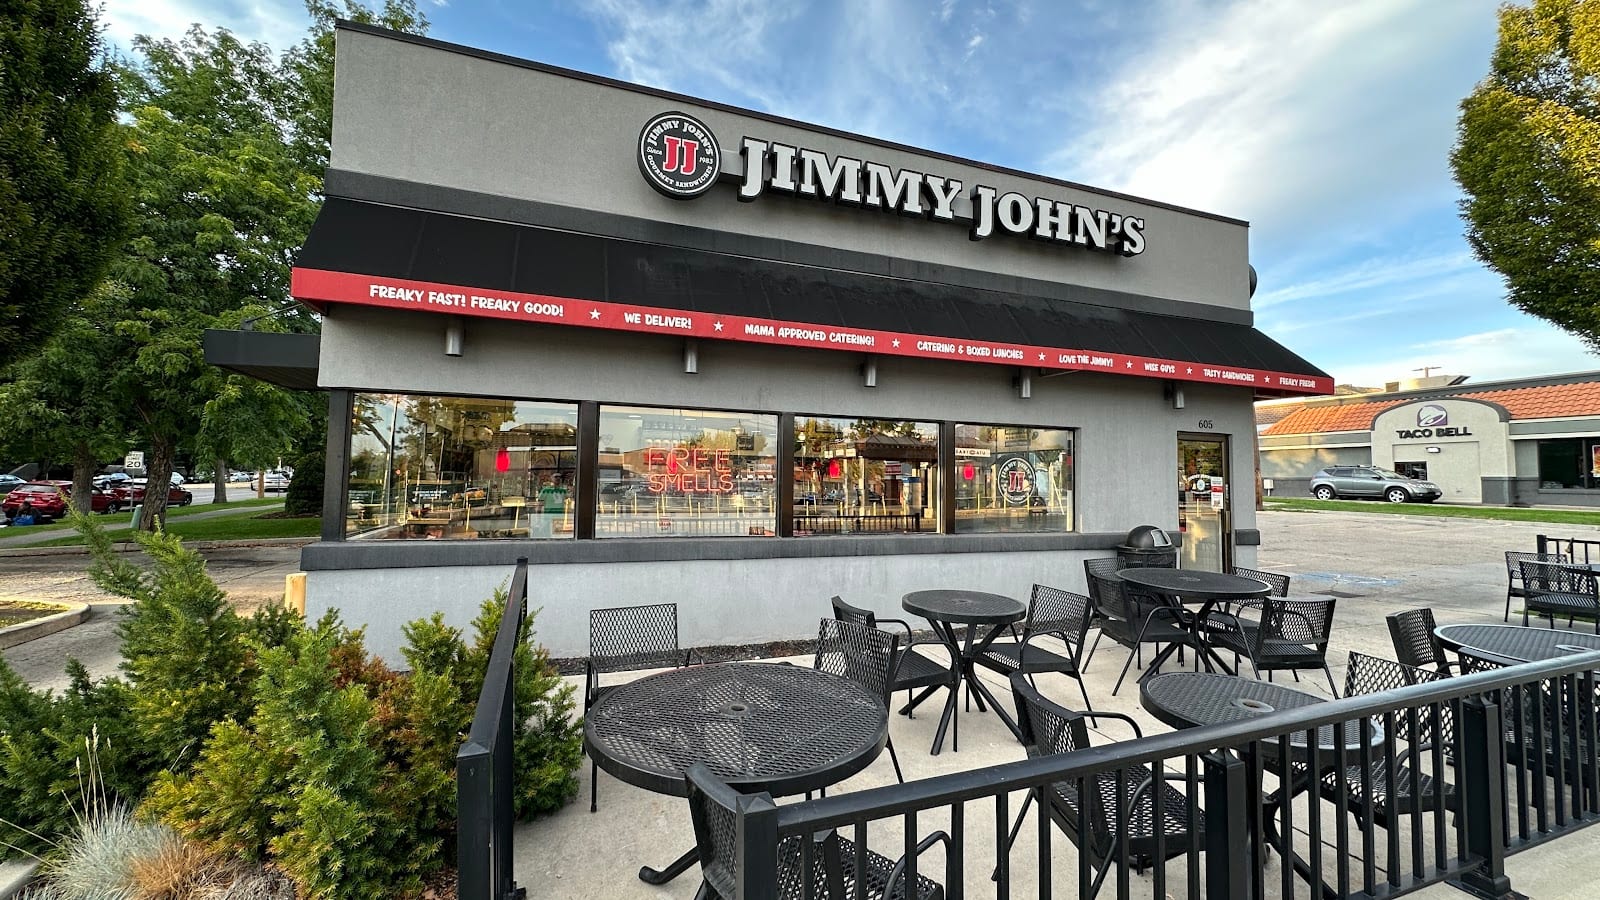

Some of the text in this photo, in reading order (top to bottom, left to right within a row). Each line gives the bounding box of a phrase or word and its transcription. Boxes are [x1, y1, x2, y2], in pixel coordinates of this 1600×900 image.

[647, 120, 713, 156] JIMMY JOHN'S
[662, 135, 699, 175] JJ
[647, 155, 713, 188] GOURMET SANDWICHES
[740, 137, 1146, 255] JIMMY JOHN'S
[369, 284, 564, 317] FREAKY FAST! FREAKY GOOD!
[624, 311, 692, 329] WE DELIVER!
[744, 323, 875, 346] MAMA APPROVED CATERING!
[917, 340, 1024, 360] CATERING & BOXED LUNCHES
[1058, 354, 1114, 368] LOVE THE JIMMY!
[1144, 362, 1176, 373] WISE GUYS
[1203, 368, 1255, 382] TASTY SANDWICHES
[1279, 376, 1299, 387] FREAKY
[1198, 419, 1213, 430] 605
[1395, 426, 1472, 439] TACO BELL
[648, 447, 732, 473] FREE
[647, 473, 733, 492] SMELLS
